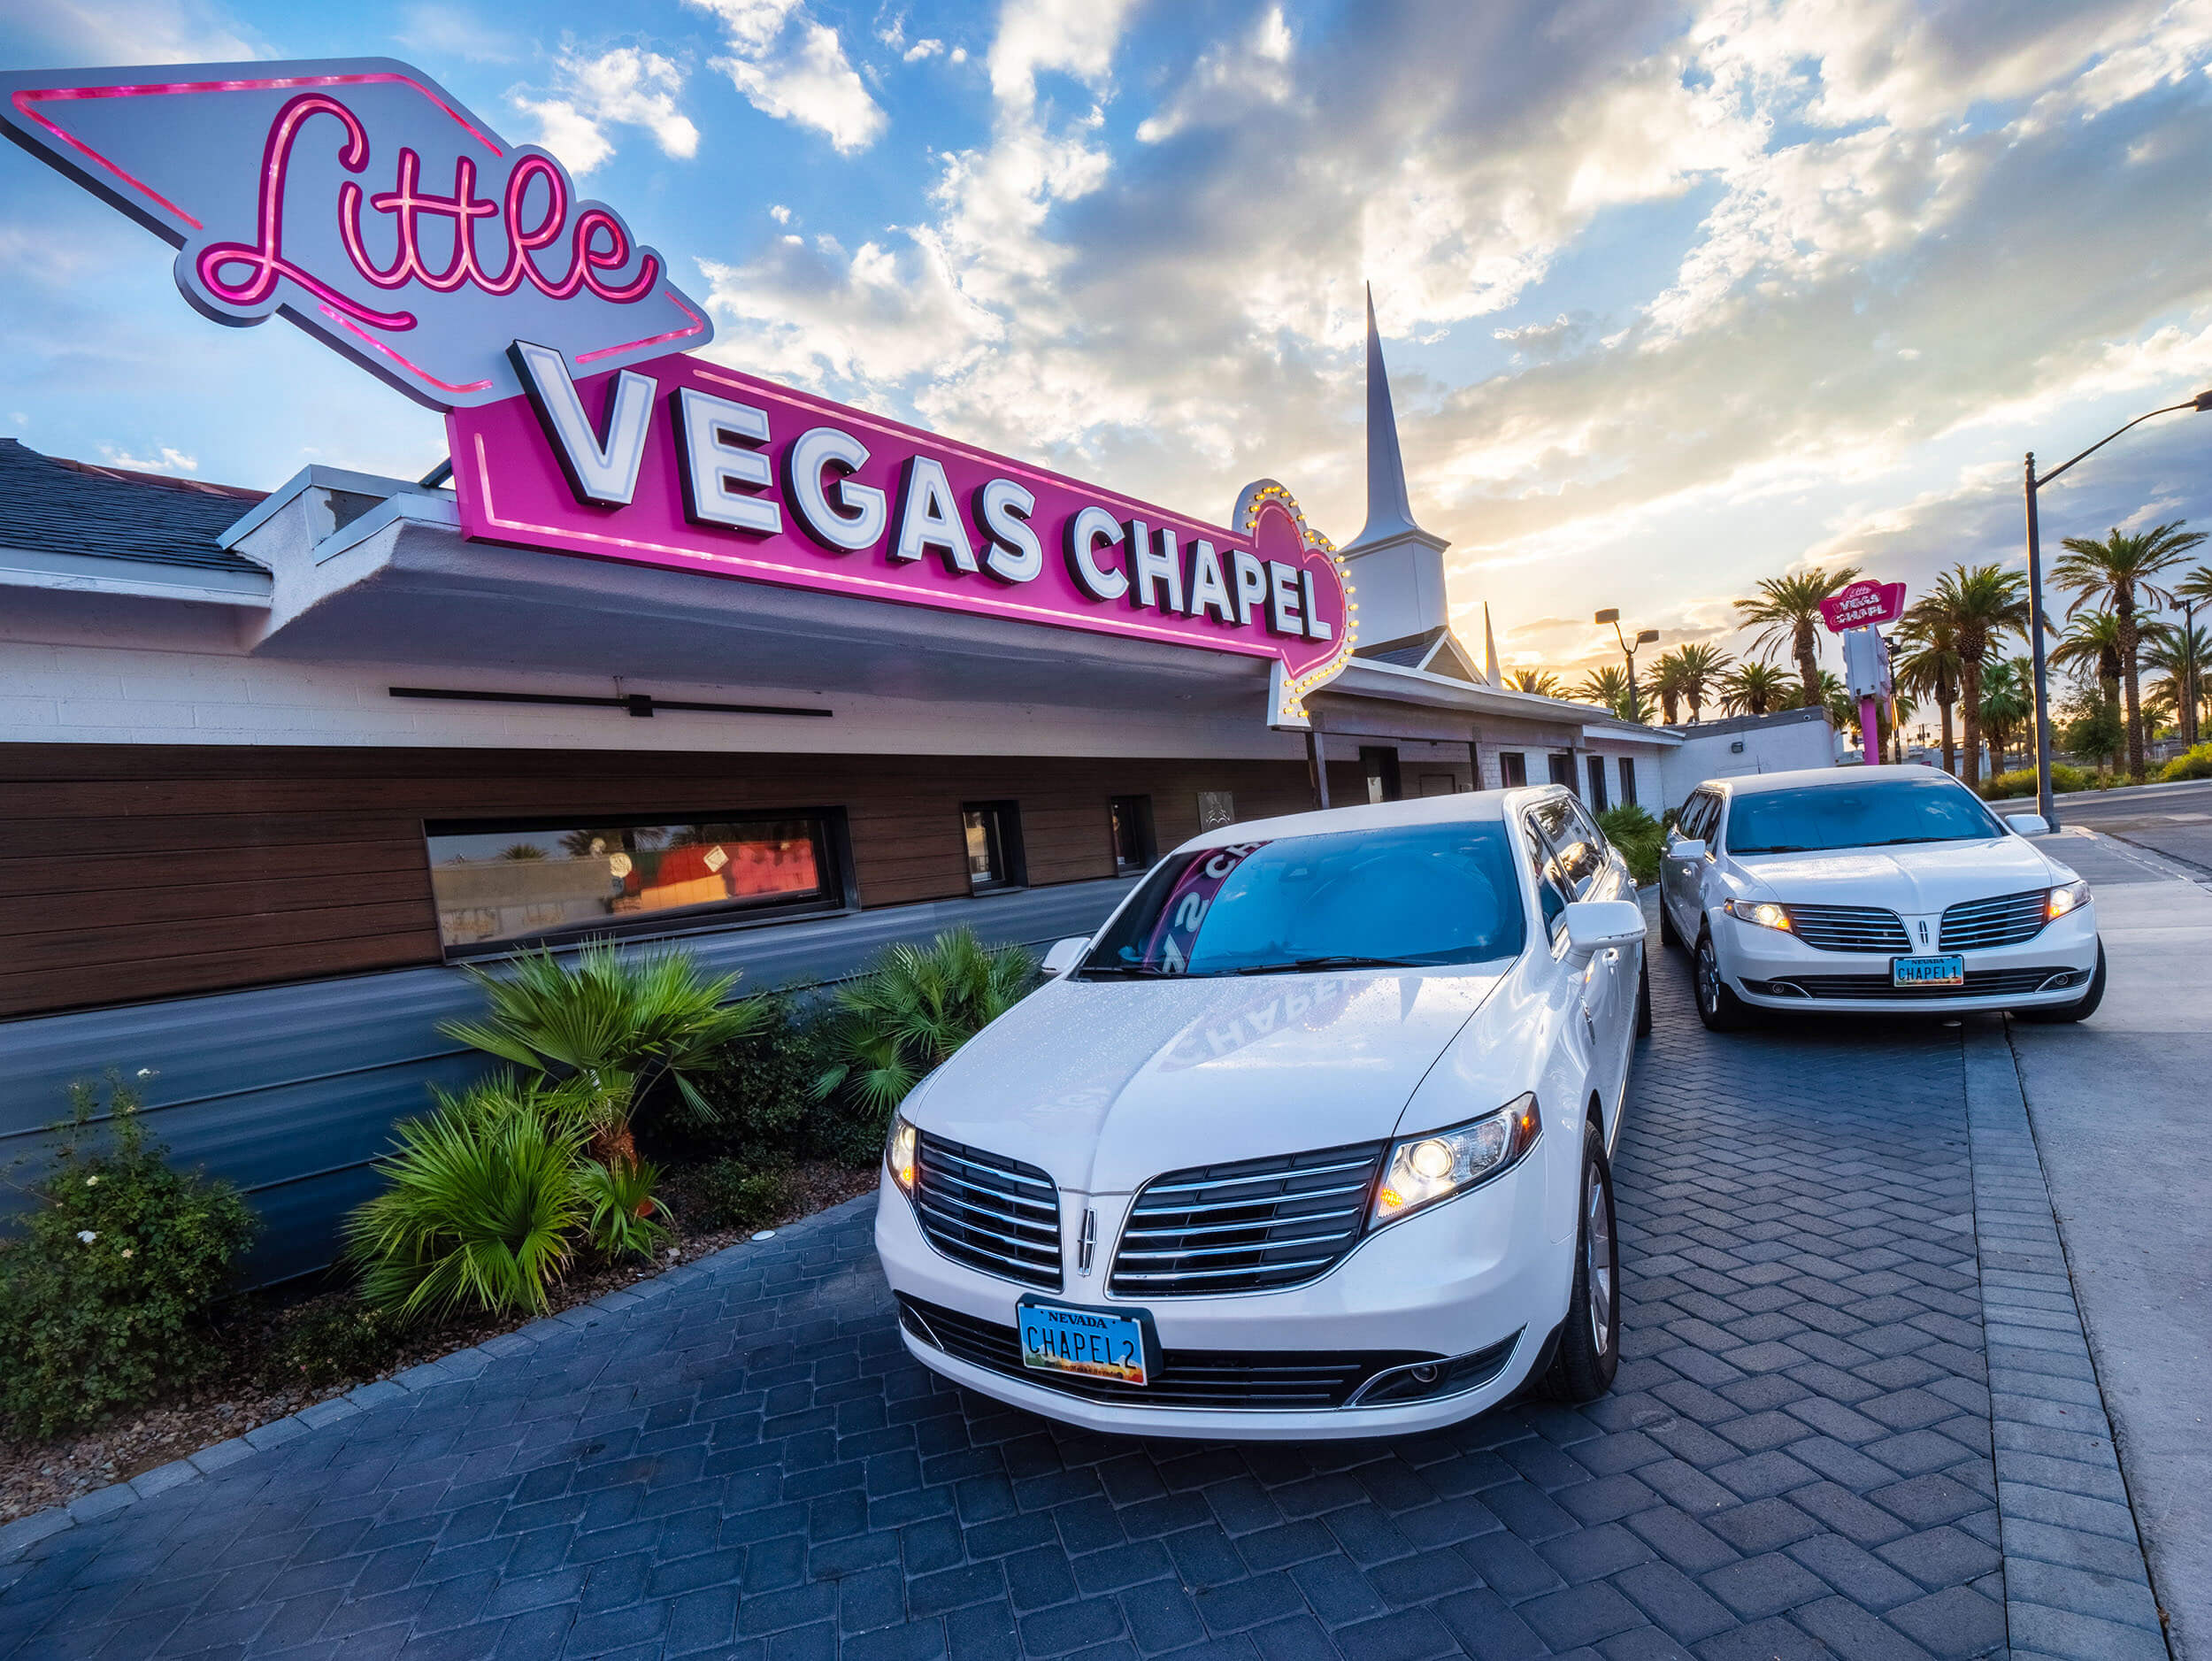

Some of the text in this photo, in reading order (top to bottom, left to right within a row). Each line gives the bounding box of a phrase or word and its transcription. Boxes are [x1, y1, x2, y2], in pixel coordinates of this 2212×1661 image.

[196, 92, 659, 332] Little
[506, 339, 1333, 642] VEGAS CHAPEL
[1048, 1311, 1108, 1329] NEVADA
